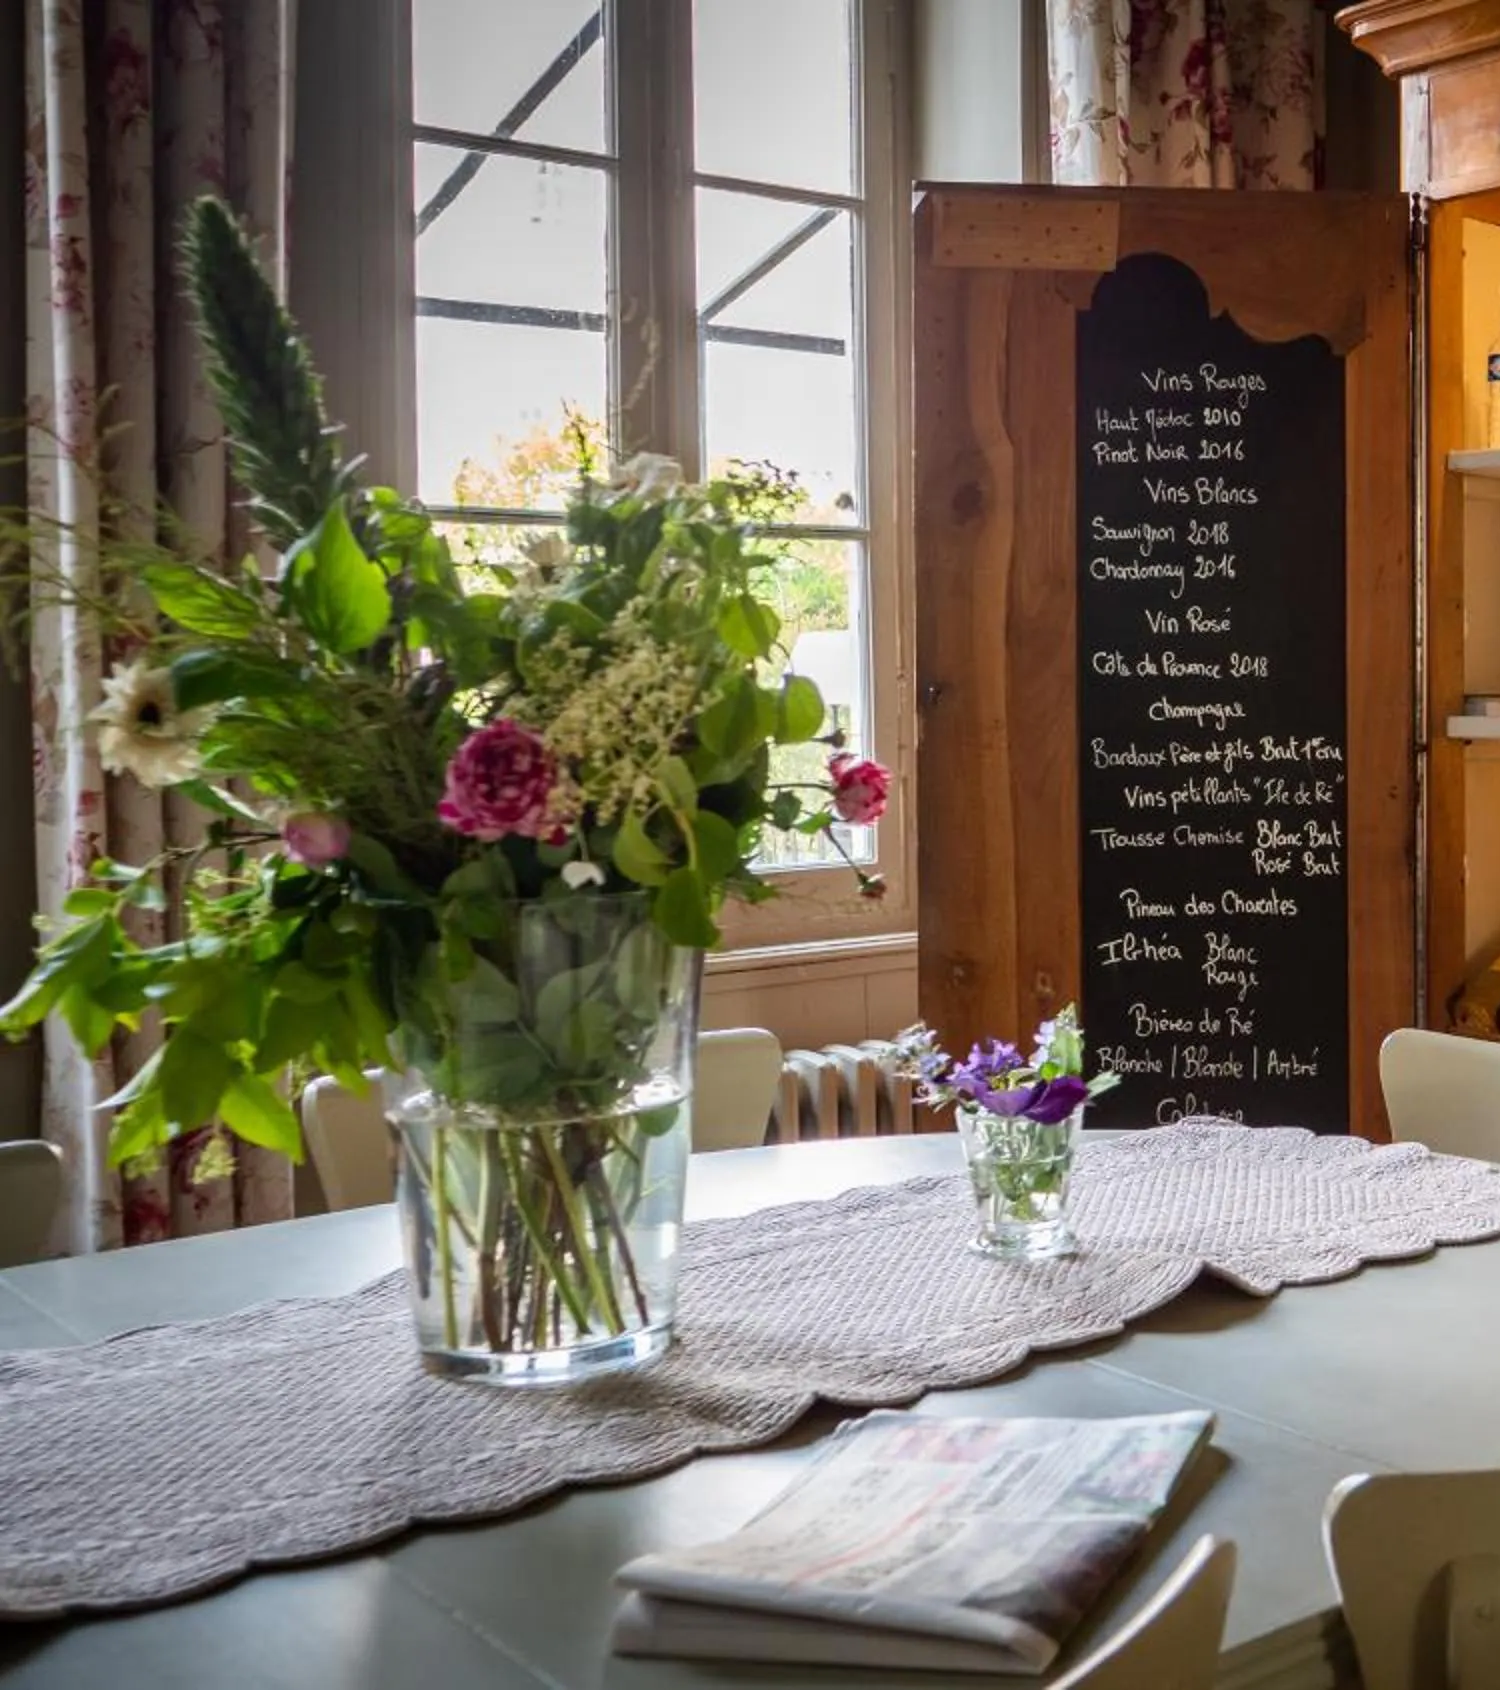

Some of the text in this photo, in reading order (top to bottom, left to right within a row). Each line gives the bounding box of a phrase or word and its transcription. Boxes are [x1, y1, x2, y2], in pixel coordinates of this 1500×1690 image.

[1142, 364, 1267, 409] Vins Rouges
[1096, 408, 1139, 434] Haut
[1203, 407, 1241, 427] 2010
[1092, 440, 1139, 465] Pinot
[1198, 440, 1245, 461] 2016
[1143, 477, 1259, 505] Vins Blancs
[1092, 516, 1230, 557] Sauvignon 2018
[1090, 555, 1237, 599] Chardonnay 2016
[1145, 605, 1232, 635] Vin Rosé
[1136, 652, 1158, 677] de
[1162, 651, 1223, 679] Provence
[1230, 652, 1269, 677] 2018
[1149, 696, 1246, 731] Champagne
[1169, 741, 1201, 766] Père
[1205, 741, 1220, 761] et
[1259, 735, 1299, 761] Brut
[1123, 785, 1167, 809] Vins
[1170, 776, 1251, 815] pétillants
[1294, 781, 1313, 806] de
[1090, 828, 1165, 851] Trousse
[1256, 819, 1302, 849] Blanc
[1304, 818, 1343, 849] Brut
[1252, 849, 1340, 877] Rosé Brut
[1120, 888, 1297, 920] Pineau des Charentes
[1205, 932, 1259, 965] Blanc
[1202, 963, 1259, 1001] Rouge
[1129, 1003, 1255, 1037] Bières de Ré
[1097, 1046, 1163, 1074] Blanche
[1182, 1045, 1243, 1078] Blonde
[1267, 1046, 1319, 1080] Ambré
